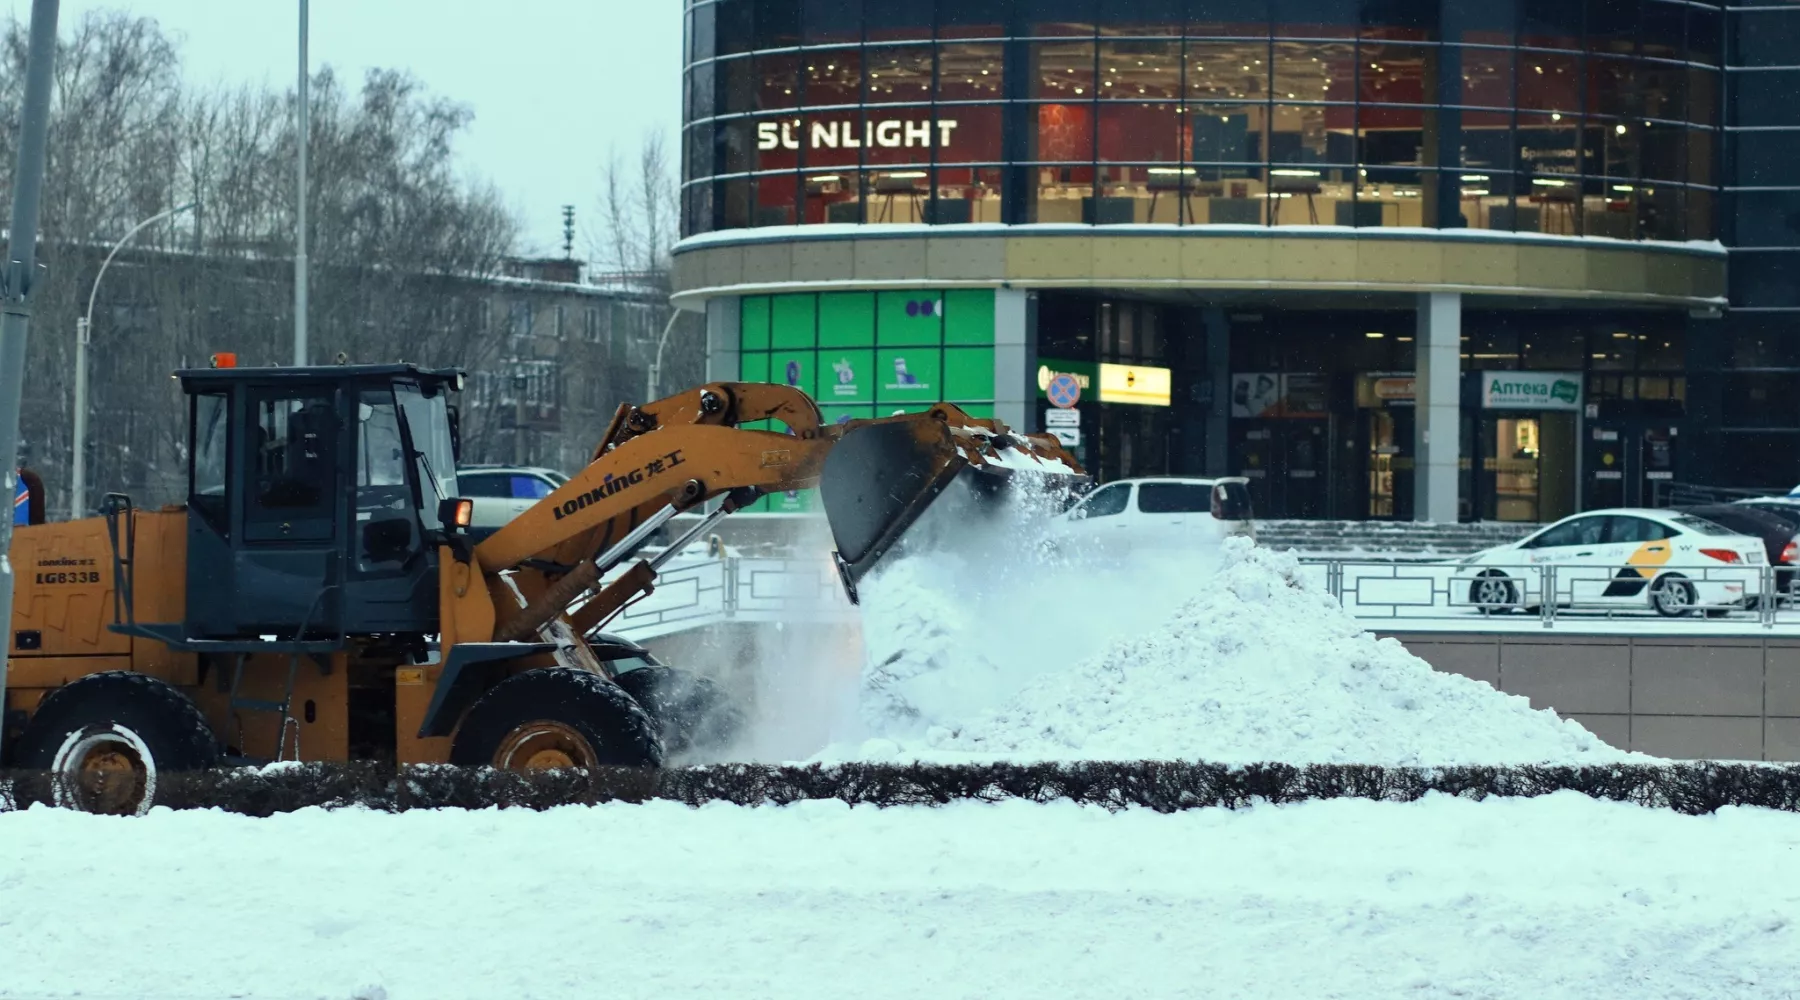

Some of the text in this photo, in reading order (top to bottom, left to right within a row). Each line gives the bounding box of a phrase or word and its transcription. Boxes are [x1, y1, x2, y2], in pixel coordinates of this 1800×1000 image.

[1489, 378, 1549, 396] Аптека
[646, 449, 686, 478] 龙工
[36, 571, 100, 584] LG833B
